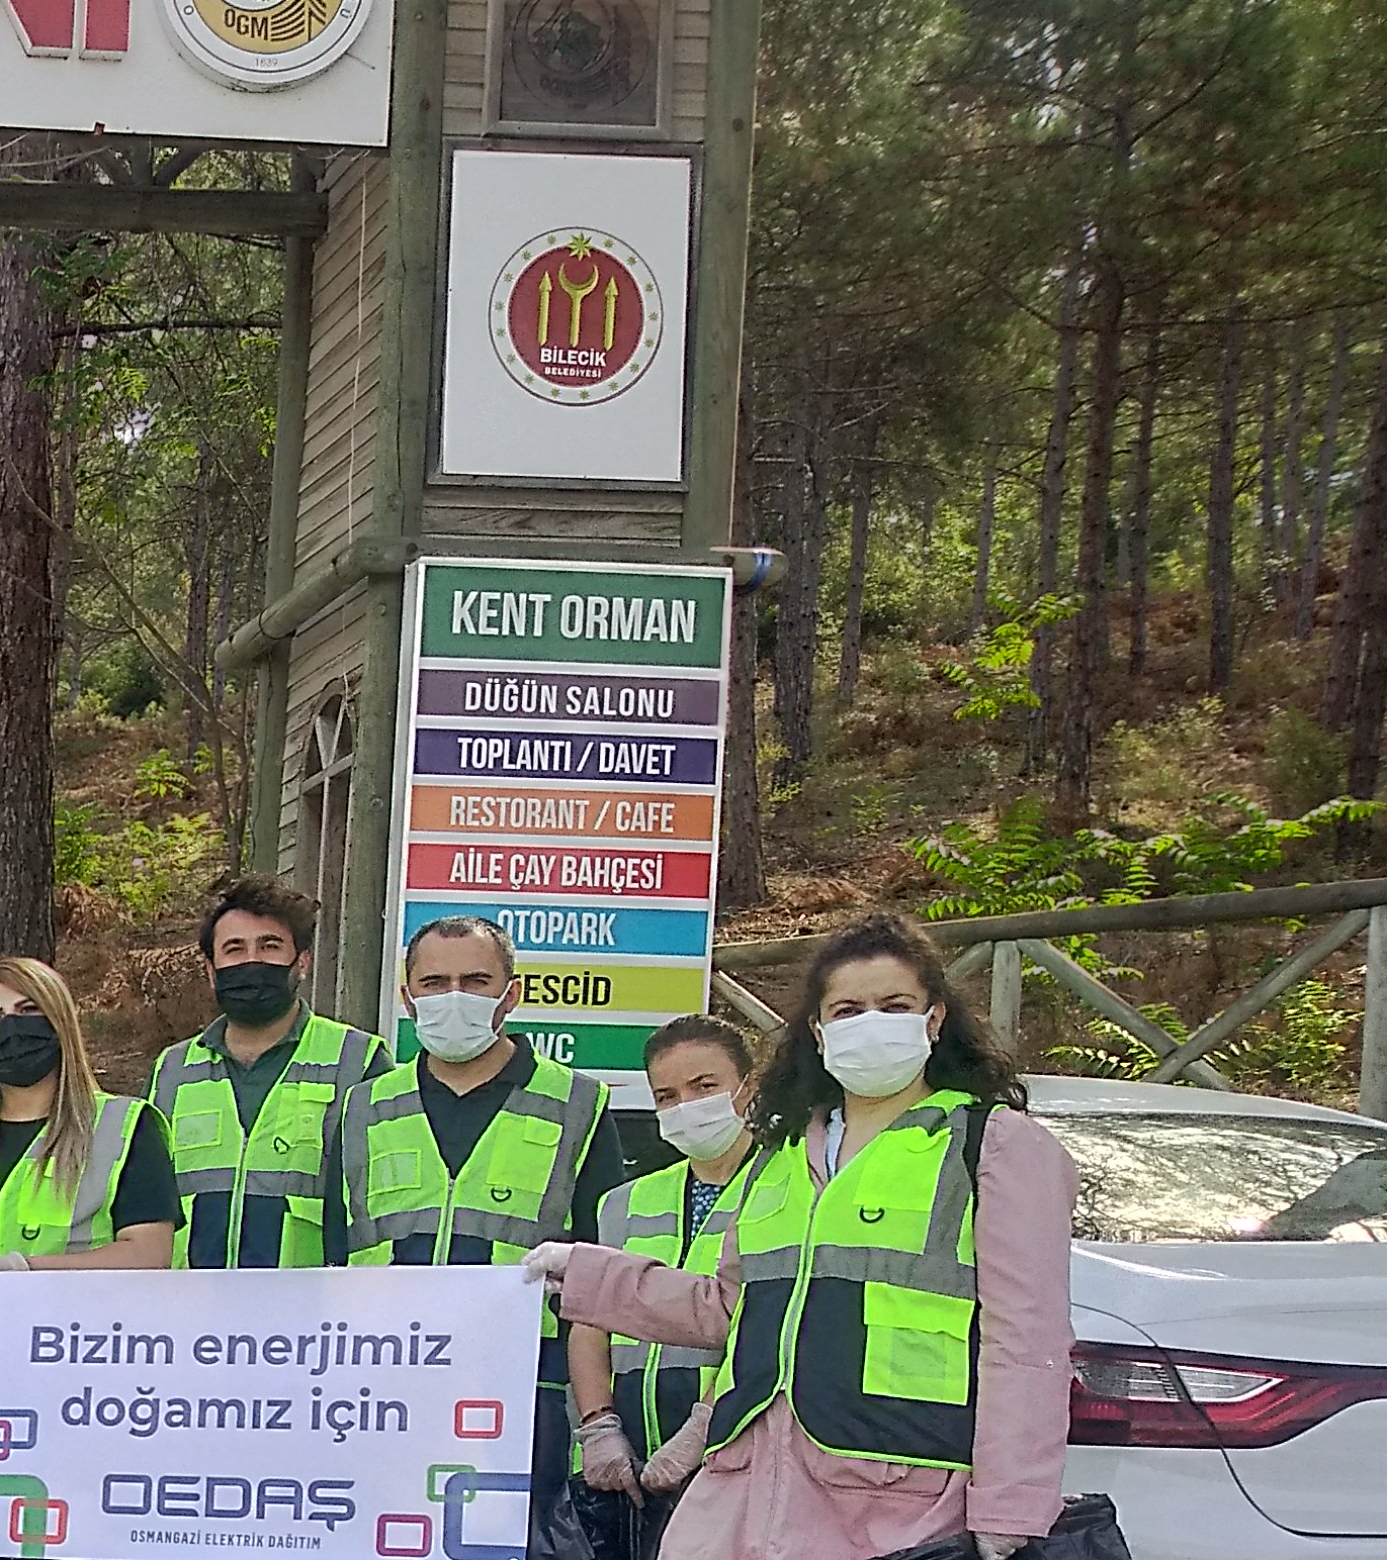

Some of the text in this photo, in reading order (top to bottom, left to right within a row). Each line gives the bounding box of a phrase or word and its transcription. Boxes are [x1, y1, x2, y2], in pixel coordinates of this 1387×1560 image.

[225, 8, 269, 41] OGM
[540, 346, 606, 367] BİLECİK
[544, 366, 602, 378] BELEDİYESİ
[451, 589, 695, 644] KENT ORMAN
[464, 677, 675, 718] DÜĞÜN SALONU
[457, 736, 676, 776] TOPLANTI / DAVET
[450, 795, 675, 834] RESTORANT / CAFE
[449, 847, 664, 894] AİLE ÇAY BAHÇESİ
[512, 970, 613, 1007] ESCİD
[28, 1321, 453, 1377] Bizim enerjimiz
[59, 1383, 409, 1444] doğamız için
[101, 1473, 356, 1533] OEDAŞ
[130, 1529, 322, 1550] OSMANGAZİ ELEKTRİK DAĞITIM
